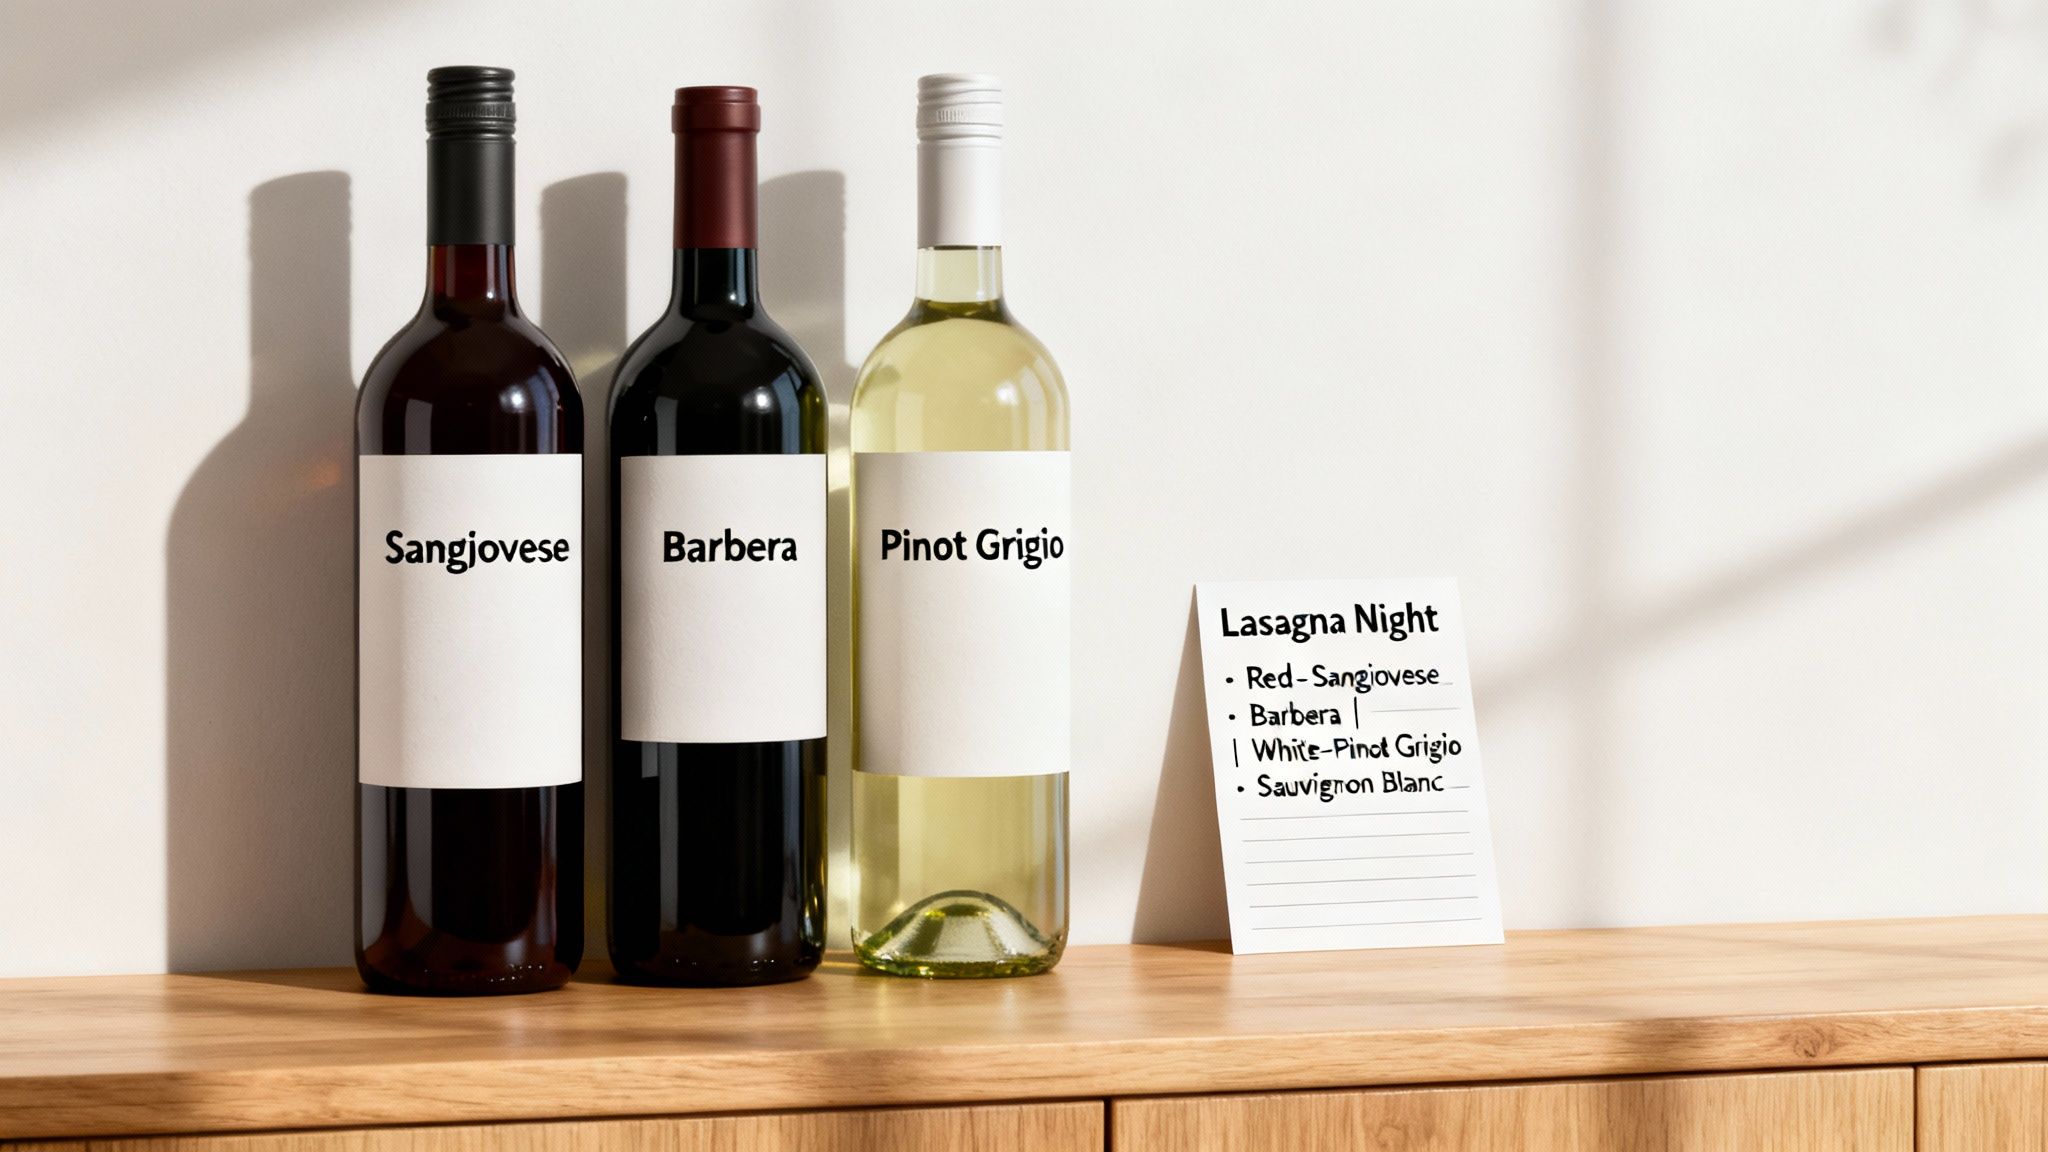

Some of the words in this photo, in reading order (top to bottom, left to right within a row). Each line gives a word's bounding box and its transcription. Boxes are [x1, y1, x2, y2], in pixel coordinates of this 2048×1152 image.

[663, 527, 797, 563] Barbera
[881, 528, 968, 562] Pinot
[975, 526, 1064, 570] Grigio
[1220, 607, 1346, 644] Lasagna
[1354, 601, 1440, 642] Night
[1249, 701, 1342, 727] Barbera
[1394, 732, 1462, 765] Grigio
[1381, 770, 1445, 794] Blanc
